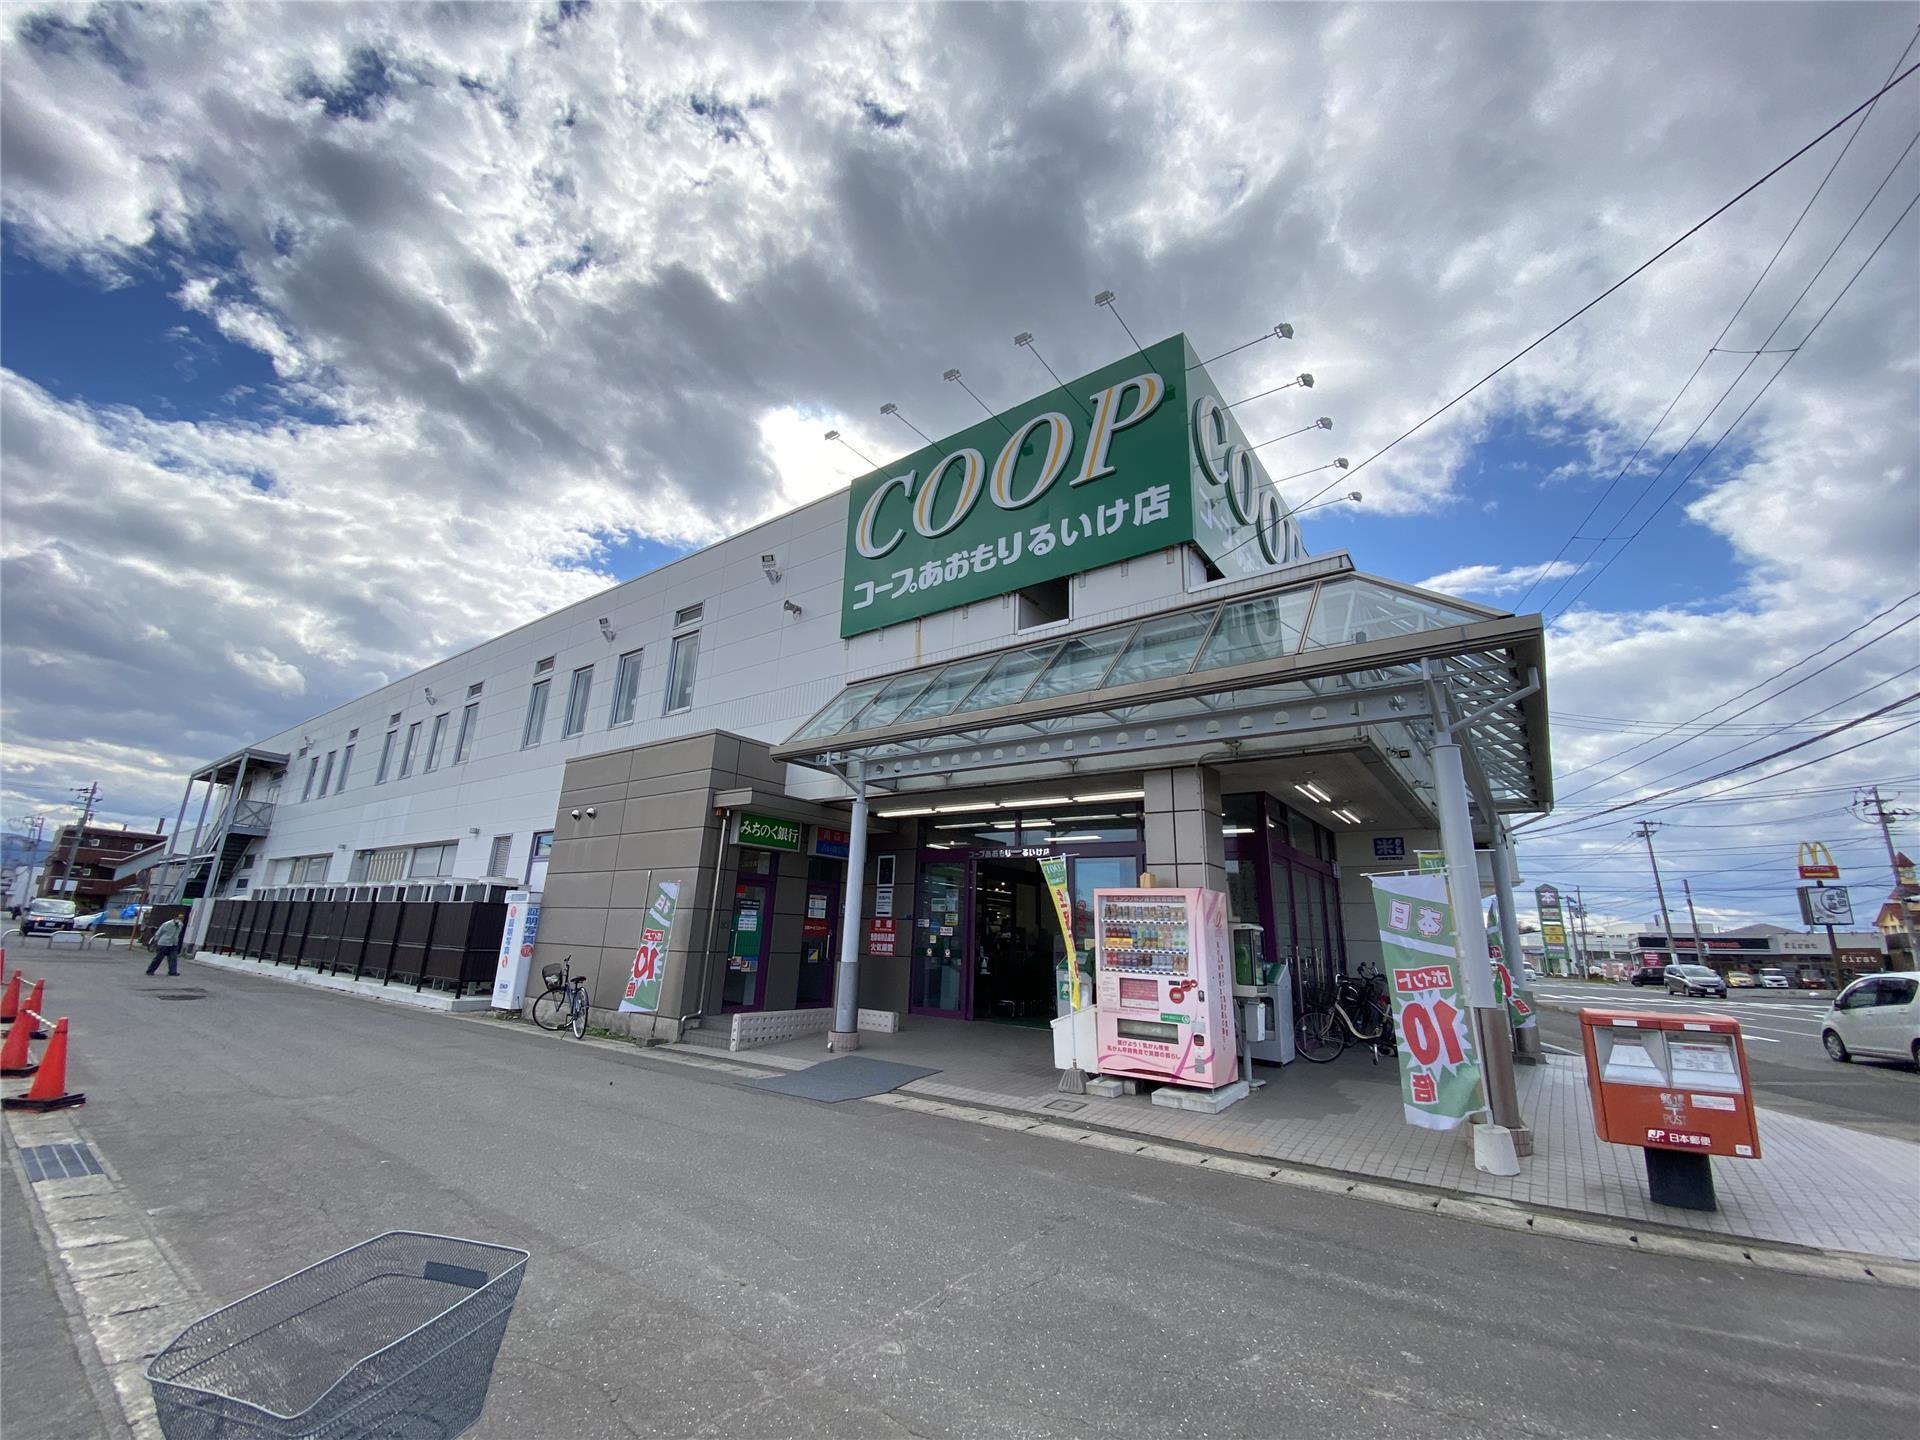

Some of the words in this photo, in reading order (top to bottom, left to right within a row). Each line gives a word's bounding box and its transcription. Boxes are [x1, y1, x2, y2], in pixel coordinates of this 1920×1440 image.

[855, 372, 1166, 560] COOP
[740, 820, 799, 843] みちのく銀行
[522, 907, 541, 945] 証明写真
[1783, 941, 1818, 950] first
[1841, 955, 1878, 963] first
[1669, 1133, 1712, 1147] 日本郵便
